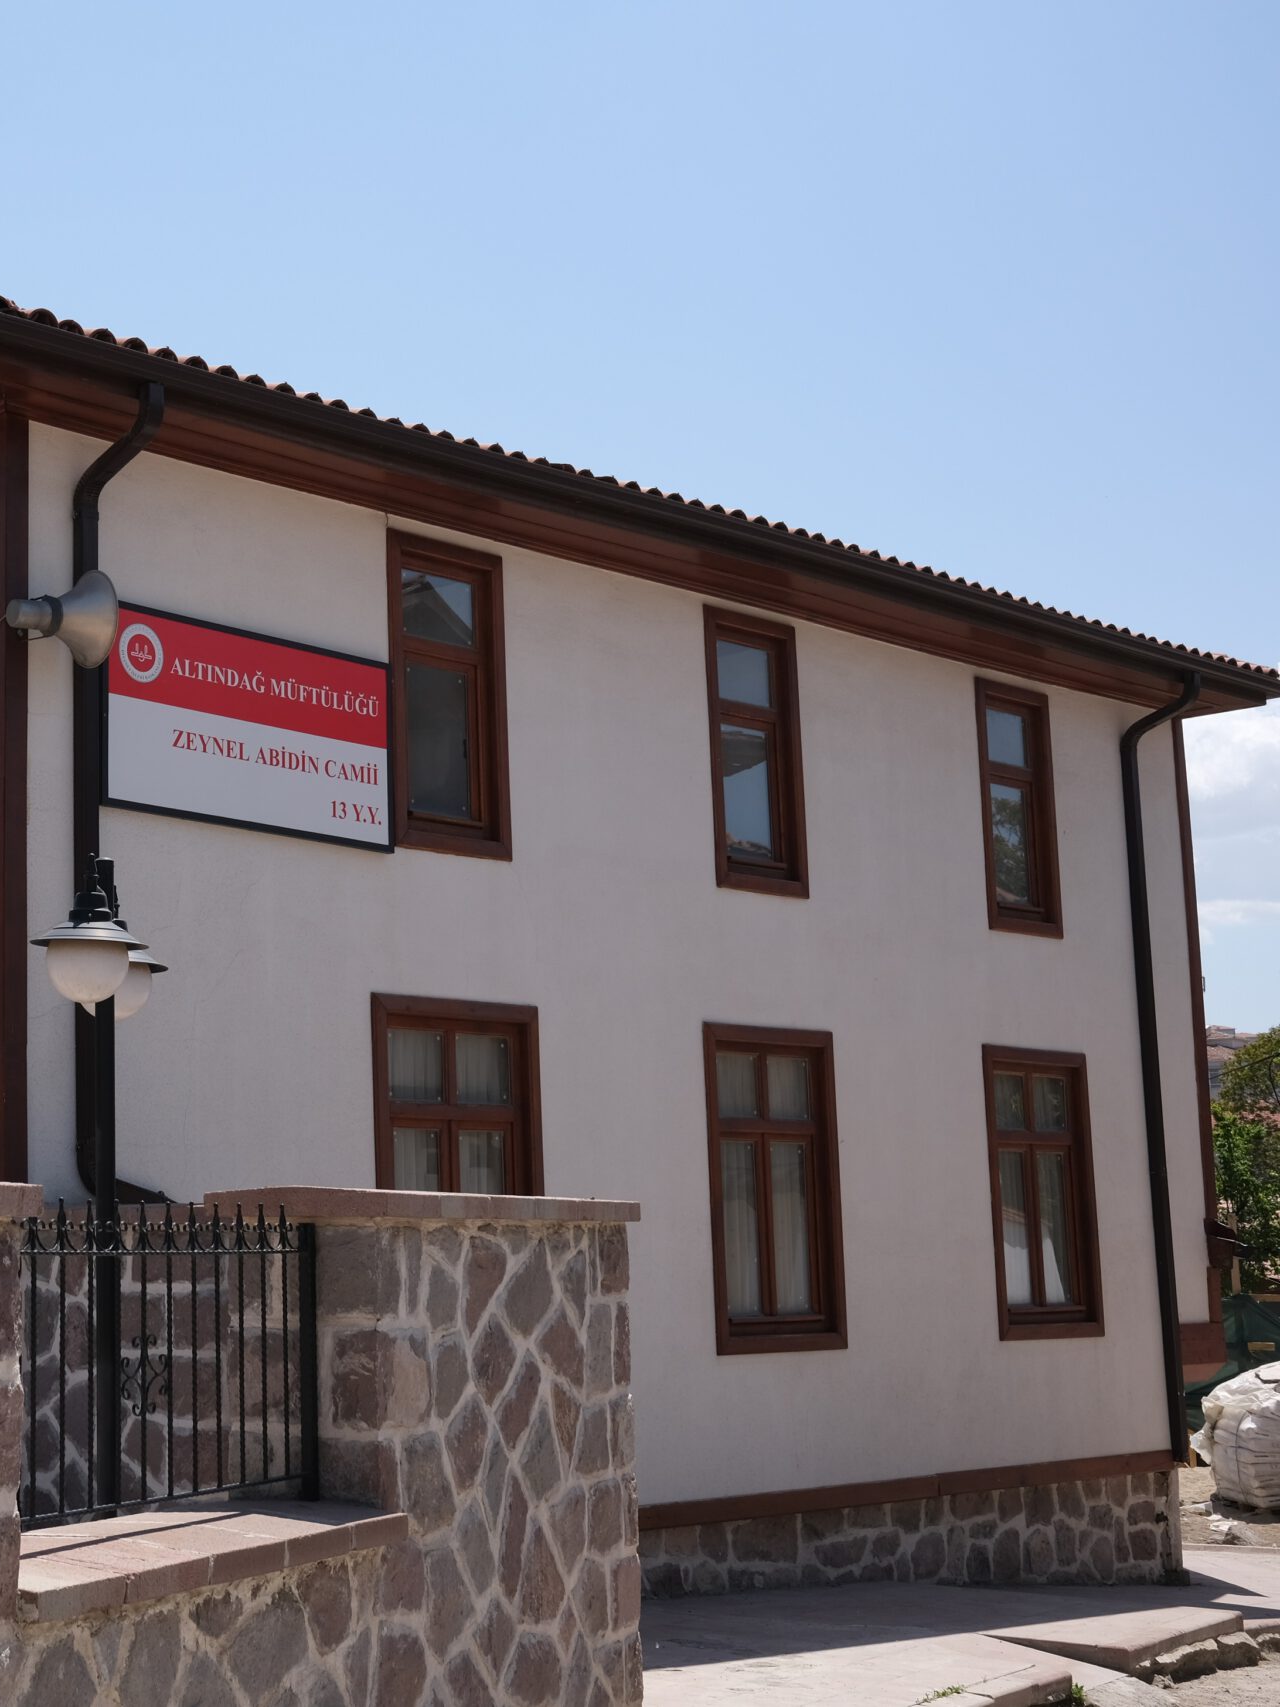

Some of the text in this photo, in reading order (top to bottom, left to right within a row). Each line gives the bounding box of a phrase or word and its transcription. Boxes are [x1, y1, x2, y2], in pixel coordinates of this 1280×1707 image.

[170, 657, 379, 717] ALTINDAĞ MÜFTÜLÜĞÜ
[172, 729, 379, 786] ZEYNEL ABİDİN CAMİİ
[331, 800, 382, 825] 13 Y.Y.
